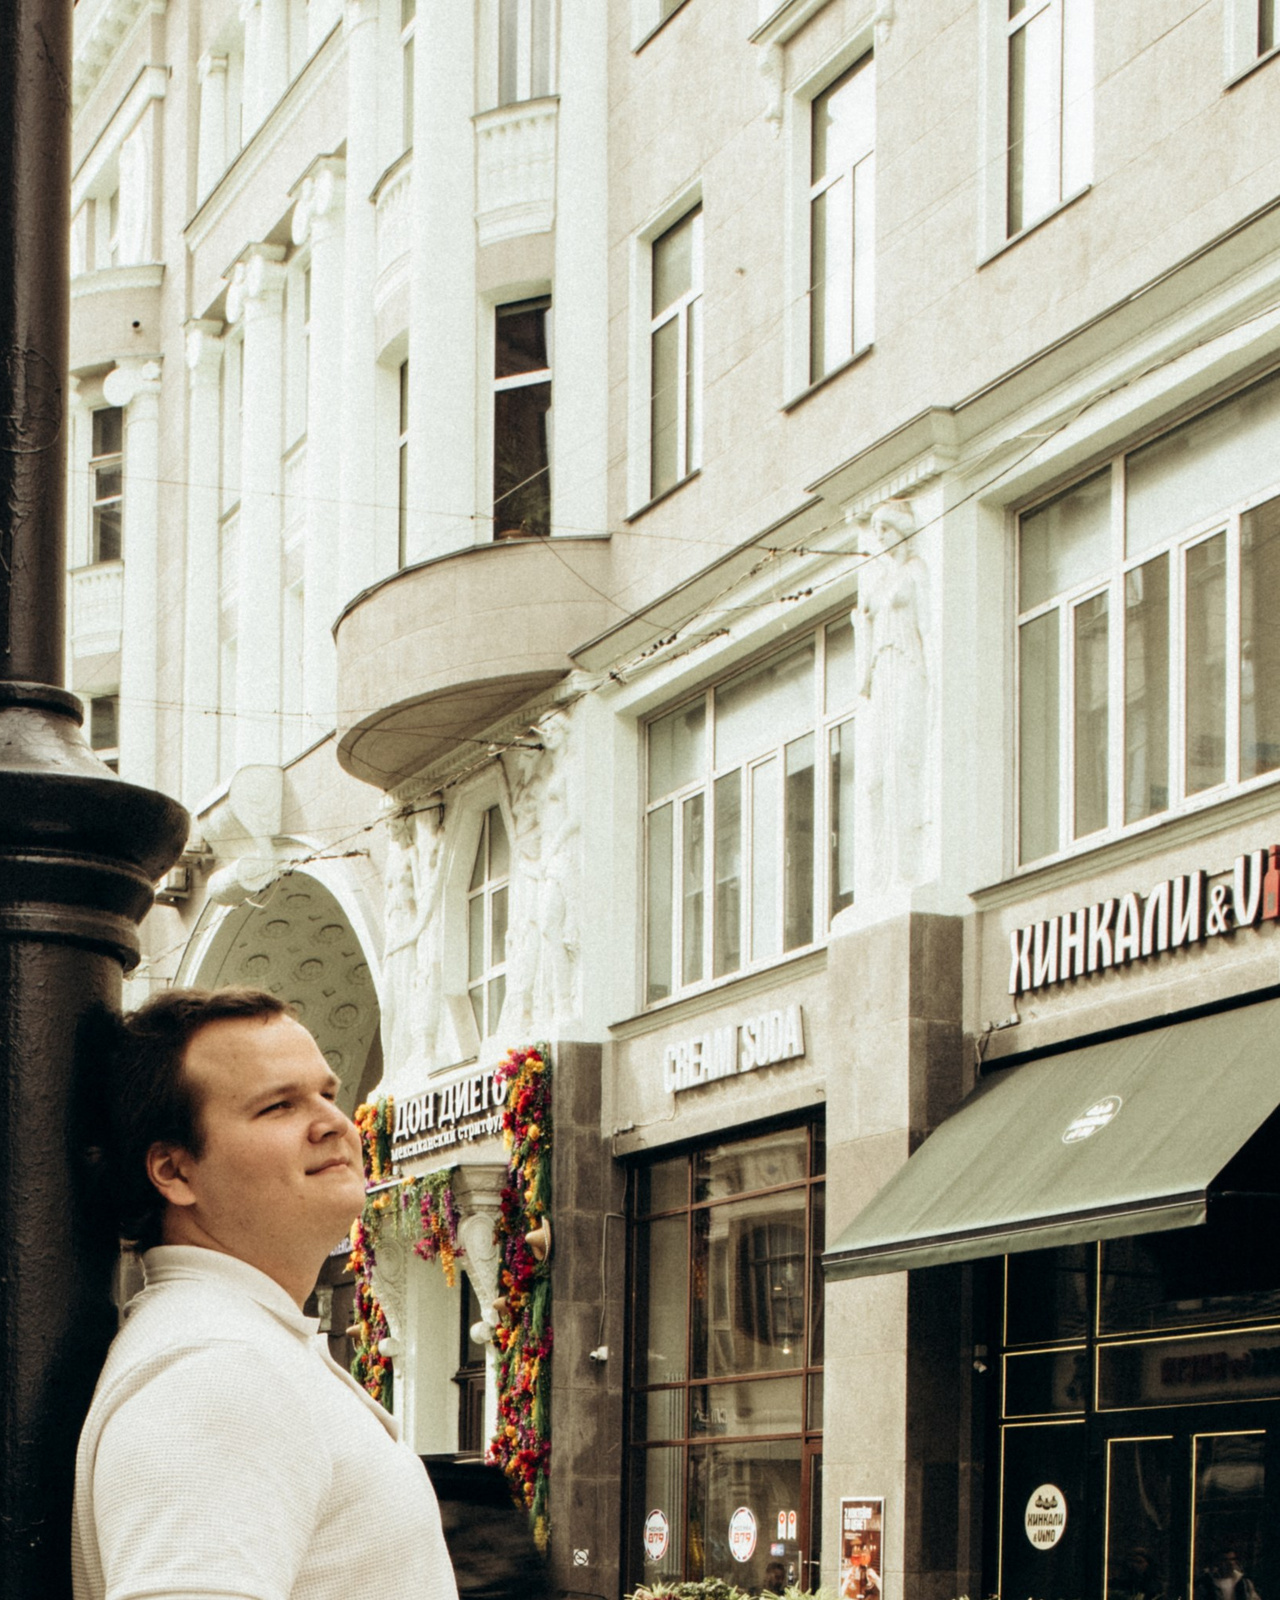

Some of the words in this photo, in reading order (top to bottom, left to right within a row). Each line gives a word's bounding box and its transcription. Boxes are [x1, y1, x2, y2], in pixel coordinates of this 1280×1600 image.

[1008, 869, 1204, 996] ХИНКАЛИ
[663, 1023, 738, 1094] CREAM
[740, 1003, 806, 1073] SODA
[392, 1091, 436, 1144] ДОН
[438, 1069, 508, 1129] ДИЕГО
[391, 1125, 457, 1162] мексиканский
[648, 1532, 664, 1544] 879
[733, 1532, 752, 1544] 879
[1027, 1513, 1064, 1527] ХИНКАЛИ
